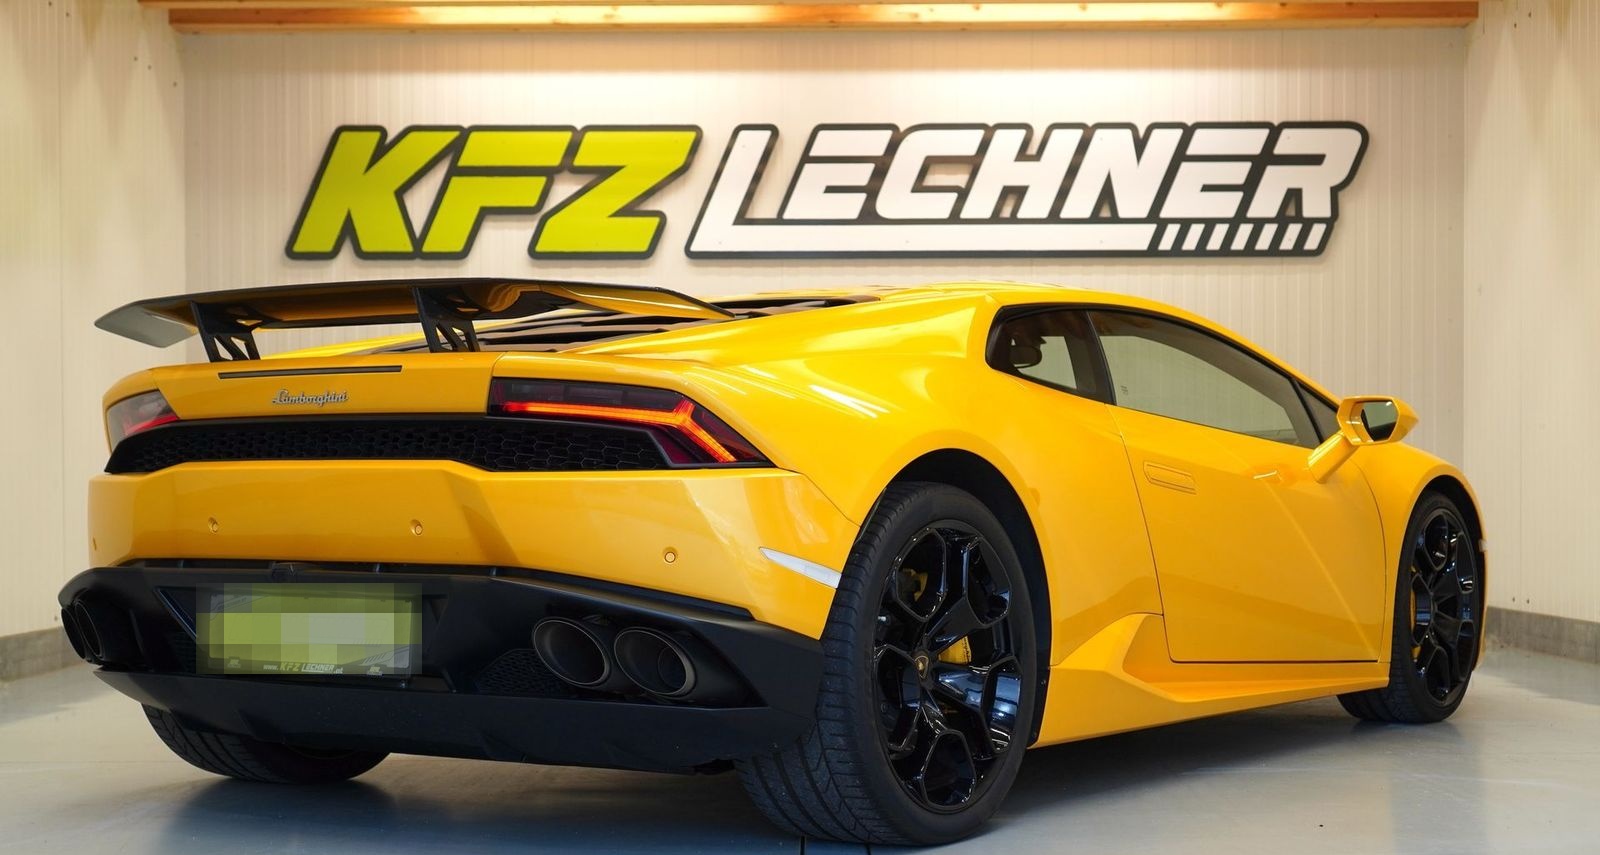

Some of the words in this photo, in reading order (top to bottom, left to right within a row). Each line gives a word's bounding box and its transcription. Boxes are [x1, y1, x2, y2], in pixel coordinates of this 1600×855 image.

[288, 127, 700, 257] KFZ
[687, 124, 1366, 256] LECHNER
[272, 388, 349, 406] Lamborghini
